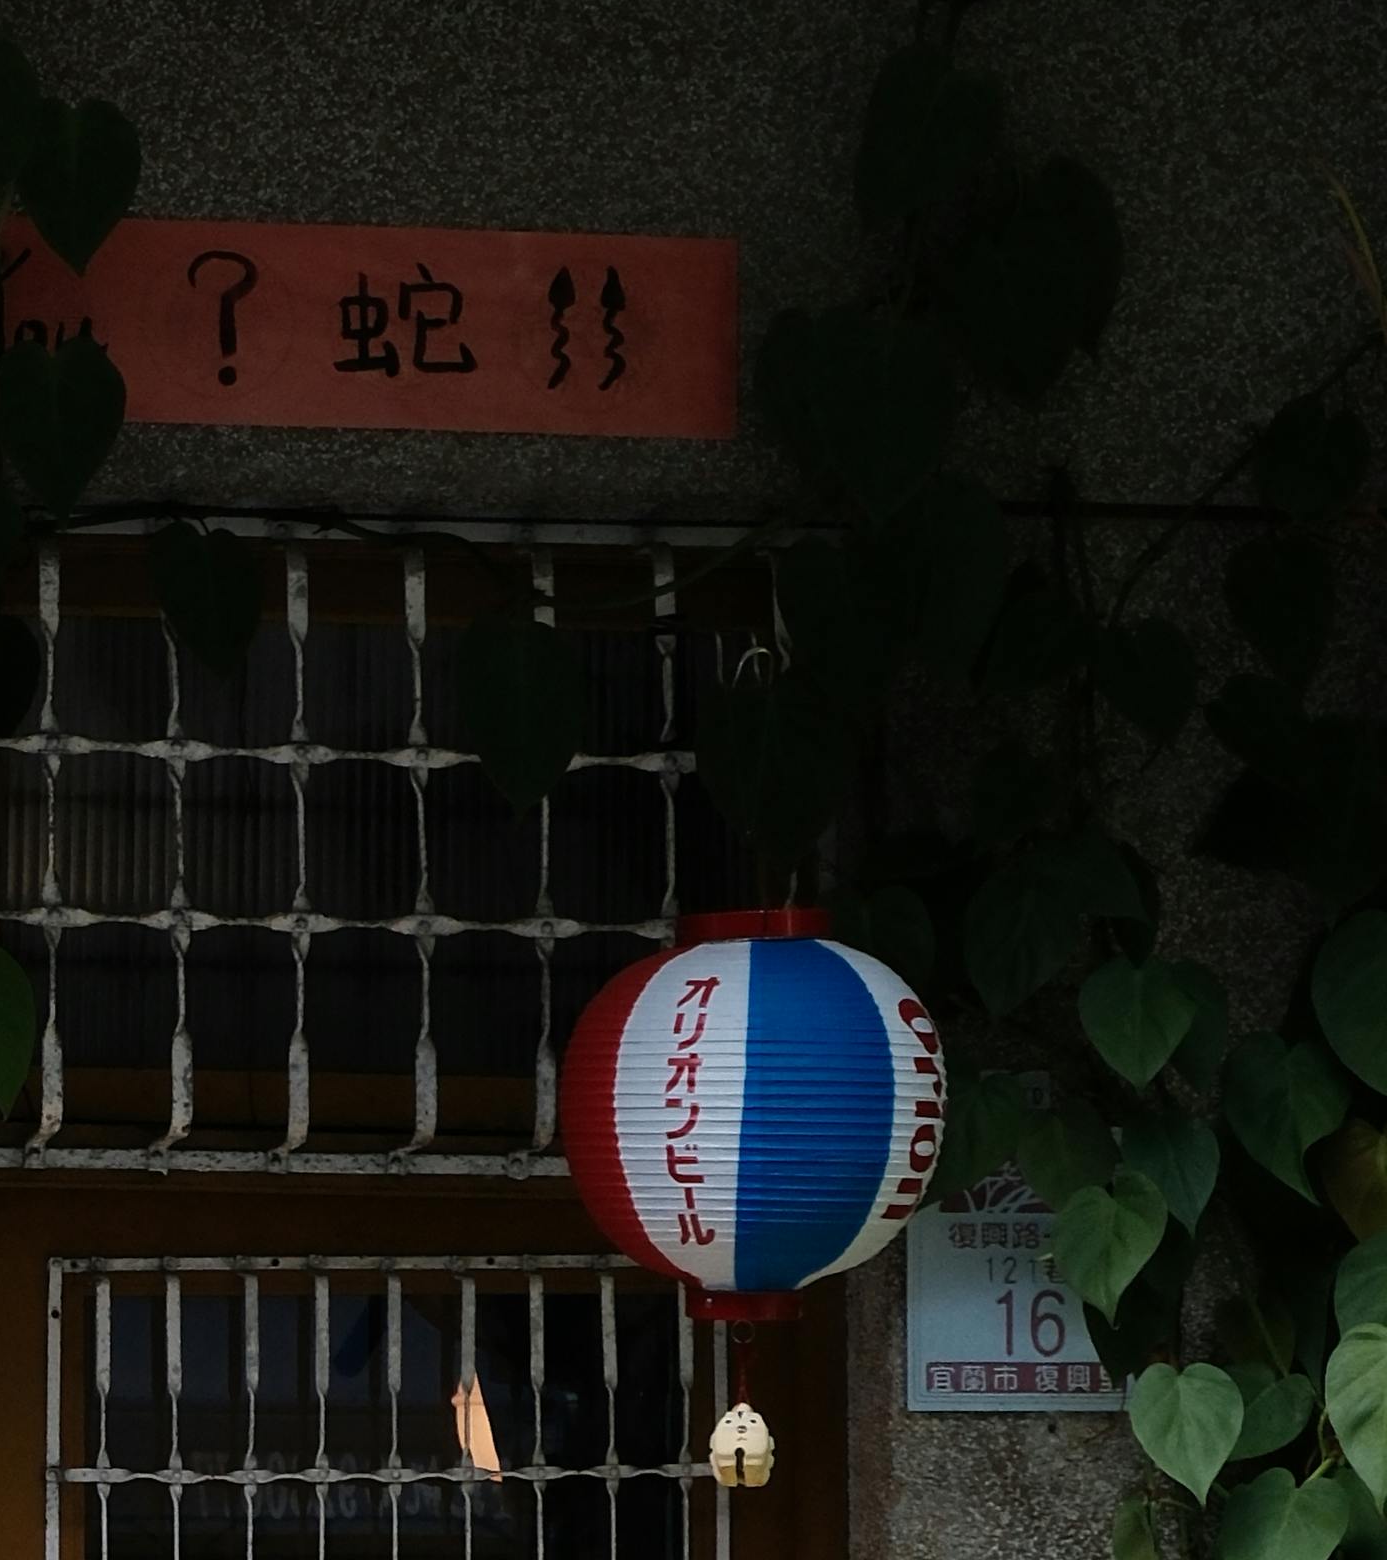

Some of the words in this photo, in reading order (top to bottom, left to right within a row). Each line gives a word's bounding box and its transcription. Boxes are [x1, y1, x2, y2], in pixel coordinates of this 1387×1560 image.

[333, 262, 478, 380] 蛇
[666, 975, 722, 1248] オリオンビール
[947, 1222, 1053, 1250] 復興路
[995, 1288, 1067, 1358] 16
[929, 1365, 1019, 1393] 宜蘭市
